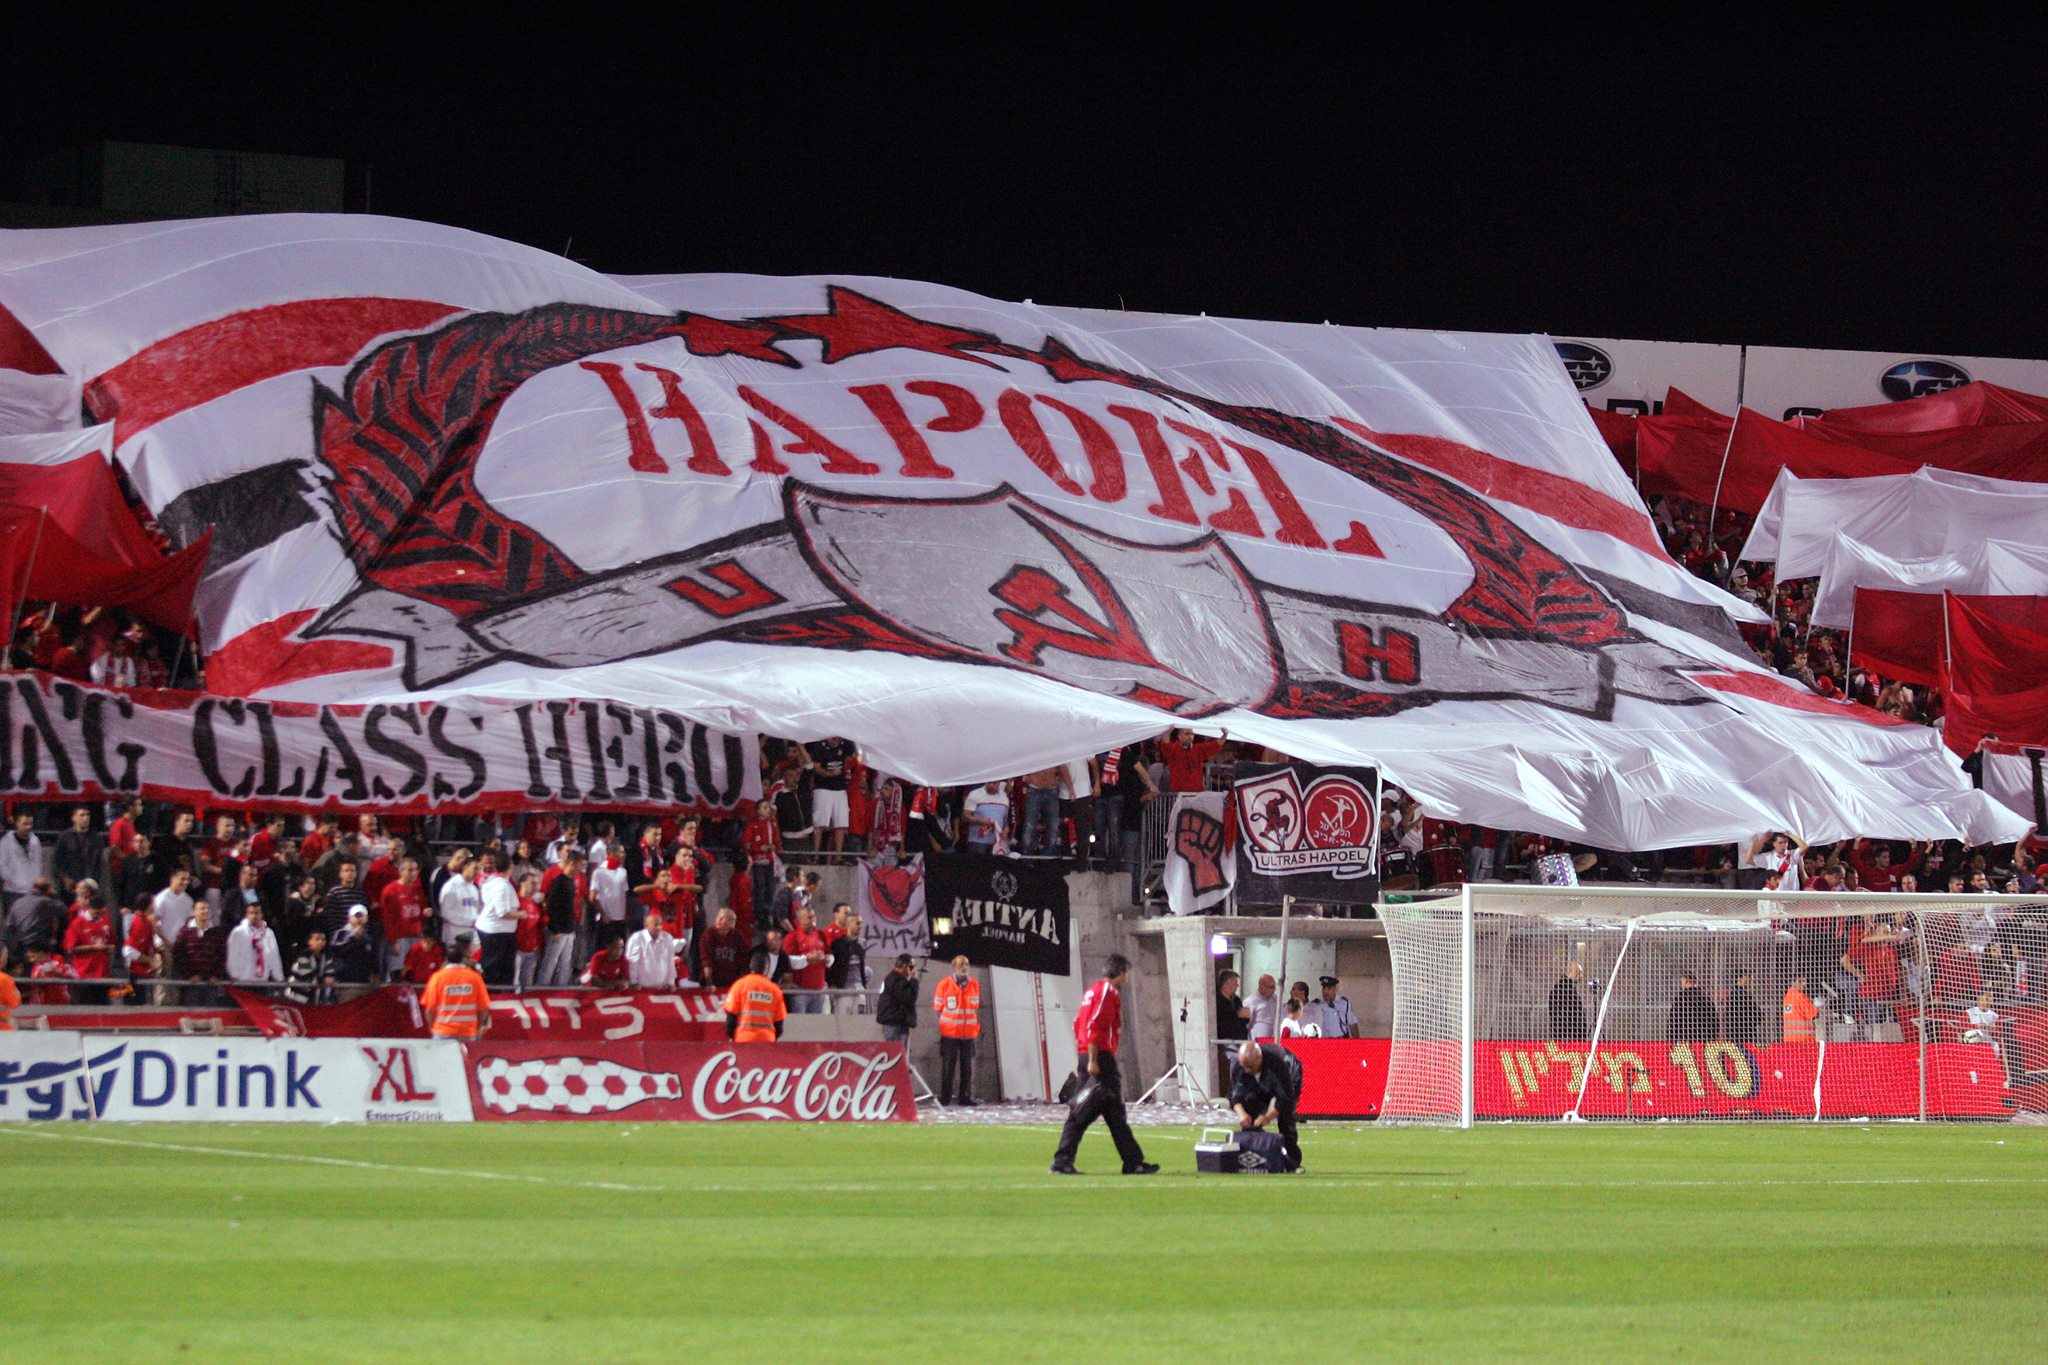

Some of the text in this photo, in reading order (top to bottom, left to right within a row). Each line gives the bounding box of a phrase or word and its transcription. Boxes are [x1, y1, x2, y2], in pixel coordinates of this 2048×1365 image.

[579, 361, 1386, 559] HAPOEL
[1332, 619, 1421, 686] H
[193, 698, 486, 800] CLASS
[515, 701, 745, 807] HERO
[1261, 850, 1365, 866] ULTRAS HAPOEL
[594, 995, 645, 1040] 5
[133, 1049, 322, 1108] Drink
[362, 1047, 436, 1101] XL
[692, 1050, 903, 1121] Coca-Cola
[1670, 1040, 1758, 1098] 10
[412, 1110, 444, 1121] Drink
